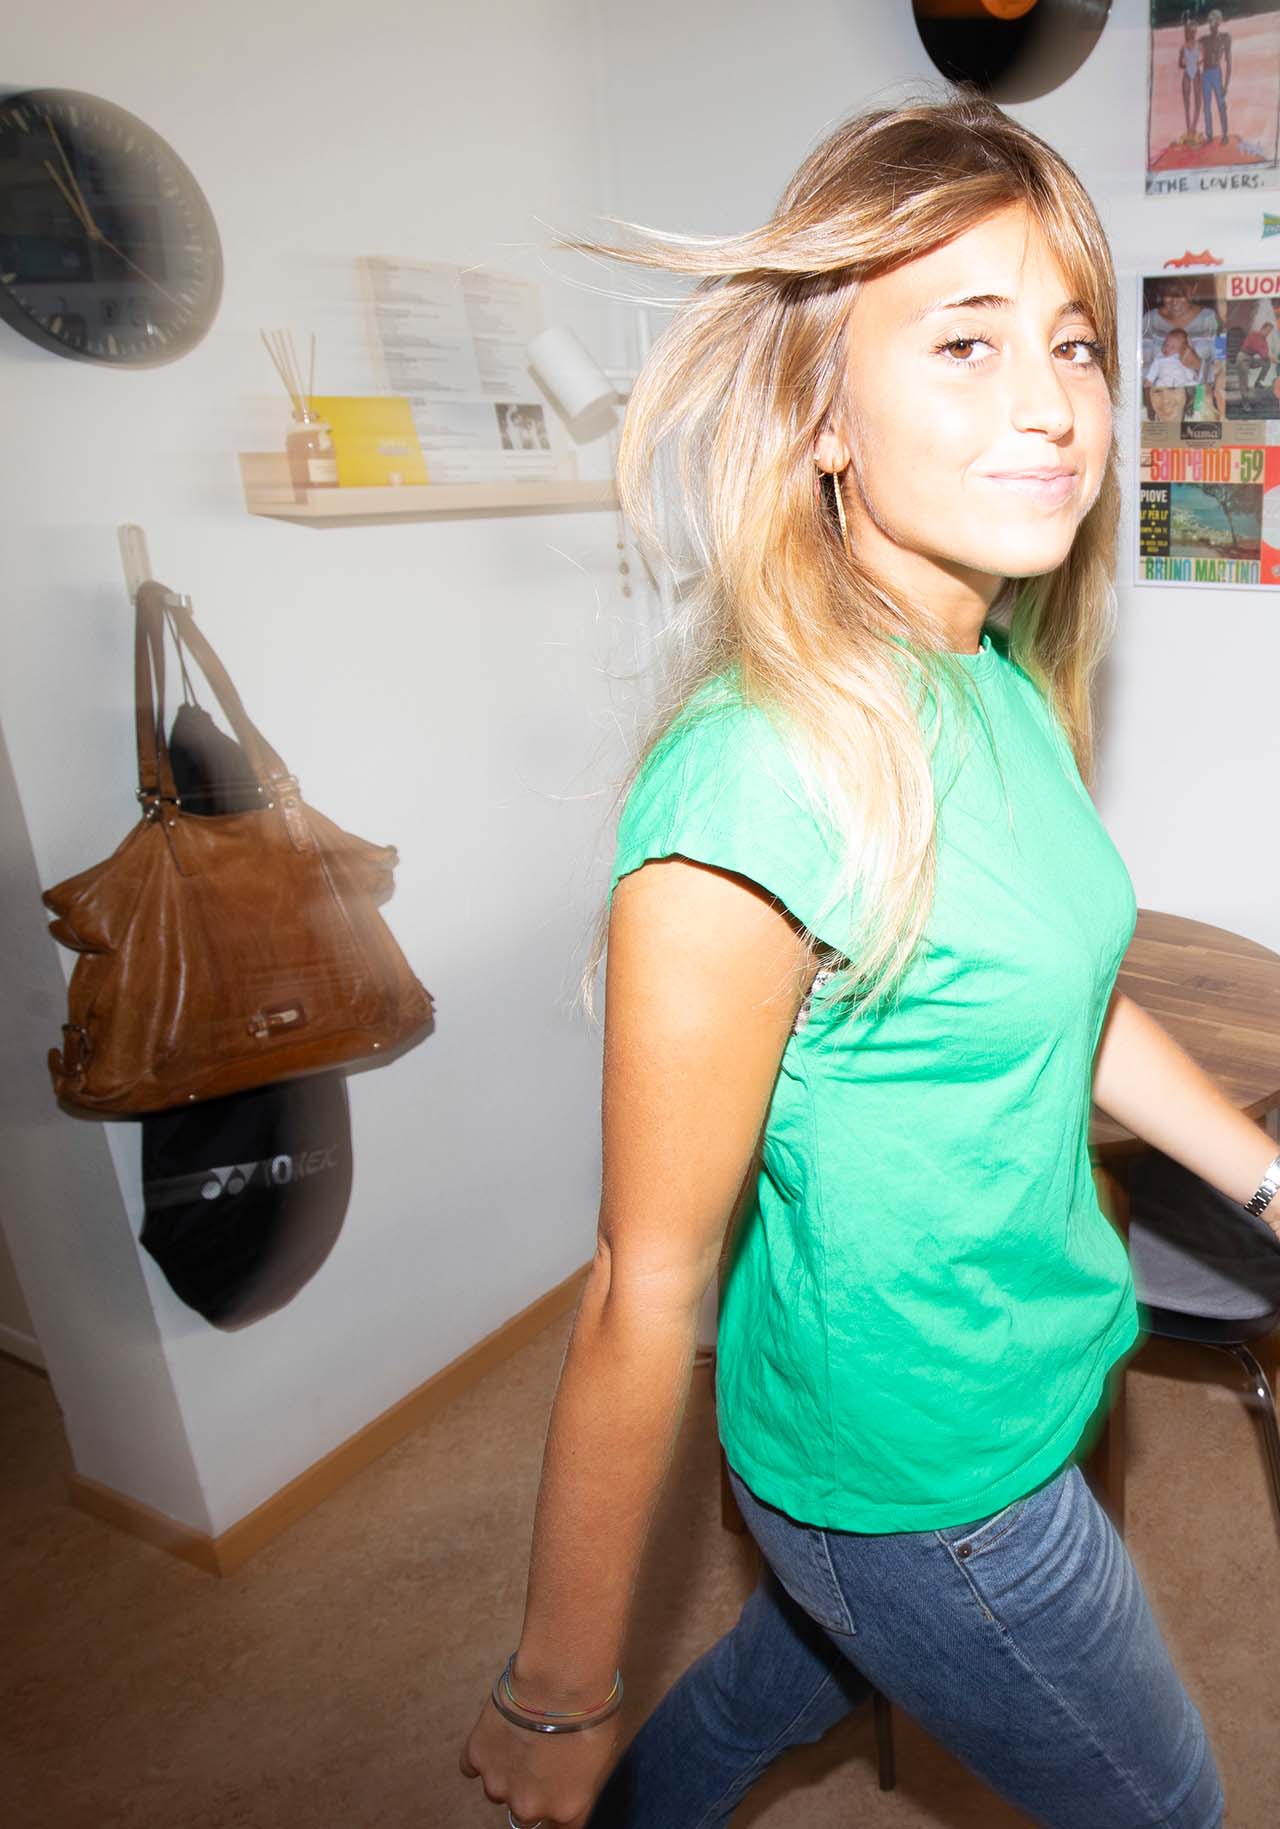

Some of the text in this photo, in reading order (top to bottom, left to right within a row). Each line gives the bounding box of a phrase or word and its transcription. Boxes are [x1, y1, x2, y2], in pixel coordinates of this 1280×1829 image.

[1140, 489, 1169, 502] PIOVE
[1146, 557, 1192, 582] BRUNO
[1195, 559, 1260, 584] MARTINO
